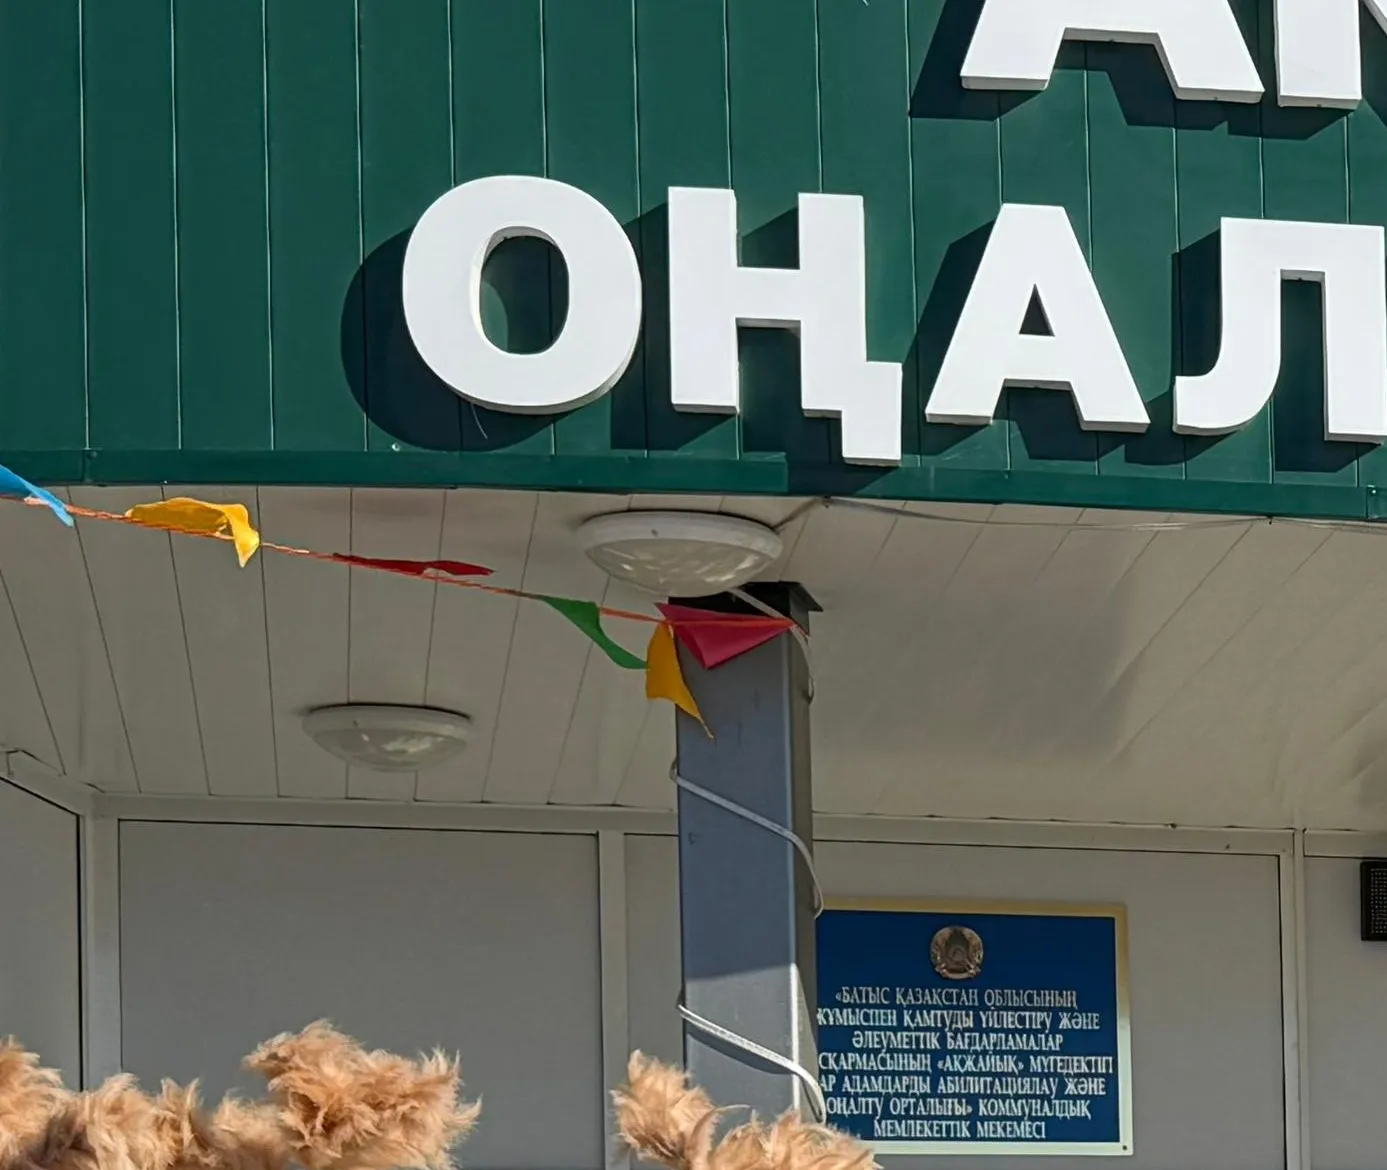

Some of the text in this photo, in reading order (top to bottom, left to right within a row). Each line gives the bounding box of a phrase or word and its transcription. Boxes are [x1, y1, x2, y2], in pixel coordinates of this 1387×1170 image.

[836, 987, 1077, 1010] «БАТЫС ҚАЗАҚСТАН ОБЛЫСЫНЫҢ
[904, 1010, 973, 1030] ҚАМТУДЫ
[1058, 1012, 1100, 1029] ЖӘНЕ
[852, 1032, 1063, 1052] ӘЛЕУМЕТТІК БАҒДАРЛАМАЛАР
[819, 1053, 932, 1072] СҚАРМАСЫНЫҢ
[937, 1053, 1023, 1073] «АҚЖАЙЫҚ»
[819, 1077, 1106, 1098] АР АДАМДАРДЫ АБИЛИТАЦИЯЛАУ ЖӘНЕ
[827, 1098, 882, 1116] ОҢАЛТУ
[979, 1099, 1091, 1120] КОММУНАЛДЫҚ
[874, 1121, 1046, 1139] МЕМЛЕКЕТТІК МЕКЕМЕСІ
